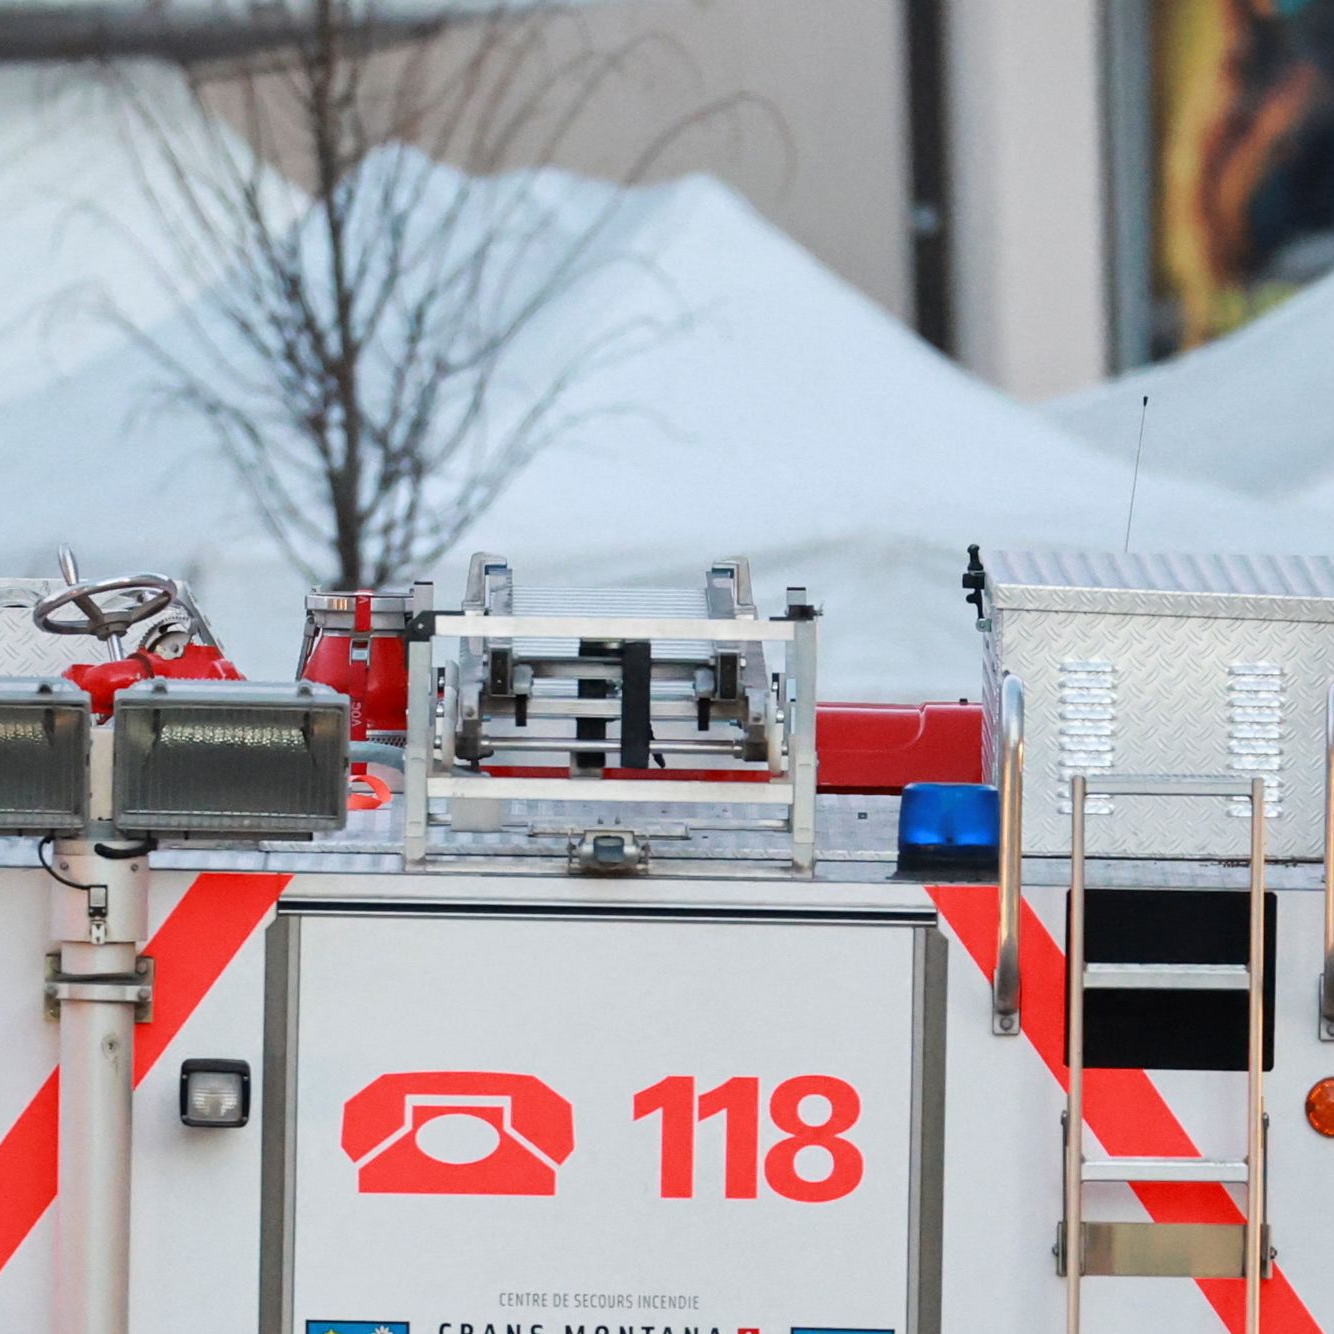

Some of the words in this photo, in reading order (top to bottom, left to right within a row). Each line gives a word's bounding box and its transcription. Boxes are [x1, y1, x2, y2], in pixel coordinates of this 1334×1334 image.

[632, 1074, 864, 1203] 118
[498, 1292, 548, 1308] CENTRE
[553, 1293, 568, 1308] DE
[573, 1293, 634, 1309] SECOURS
[637, 1295, 700, 1310] INCENDIE
